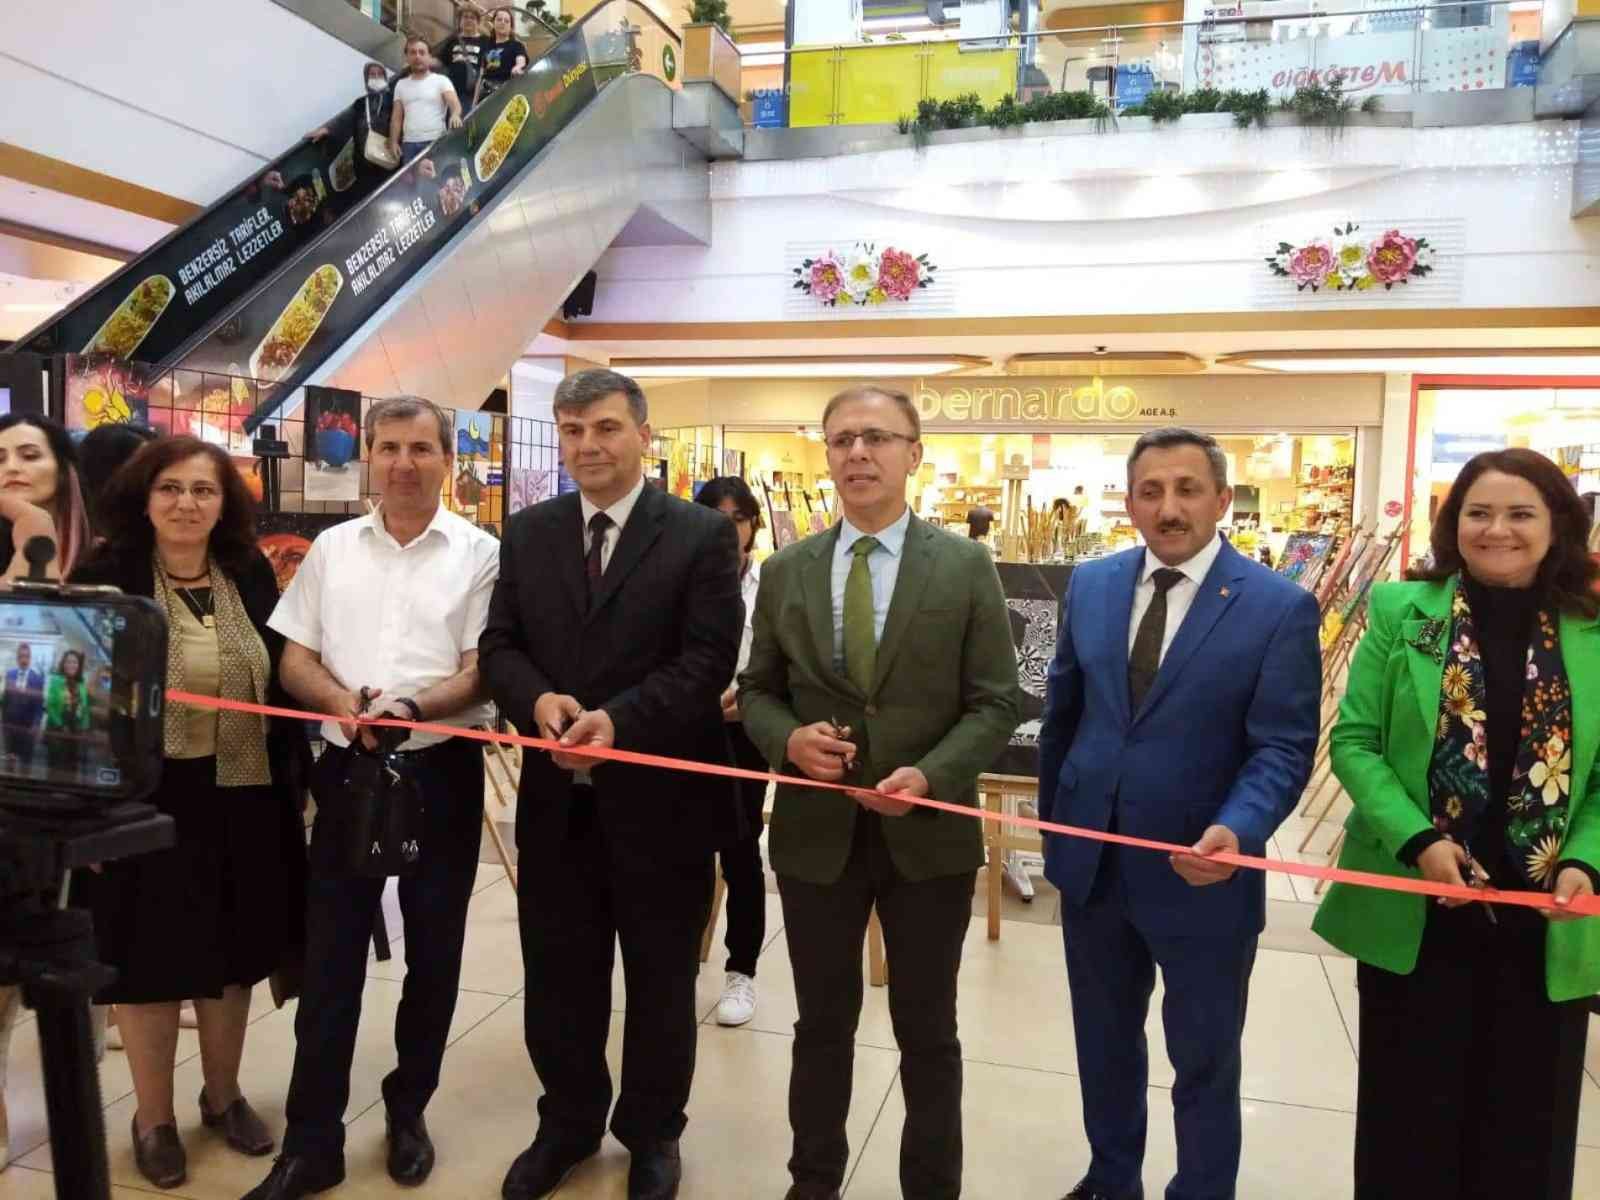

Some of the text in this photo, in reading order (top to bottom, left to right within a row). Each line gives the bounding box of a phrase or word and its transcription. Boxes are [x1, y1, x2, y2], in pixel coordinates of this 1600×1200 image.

[184, 220, 283, 305] AKILALMAZ LEZZETLER
[351, 210, 436, 296] AKILALMAZ LEZZETLER
[914, 376, 1139, 420] bernardo
